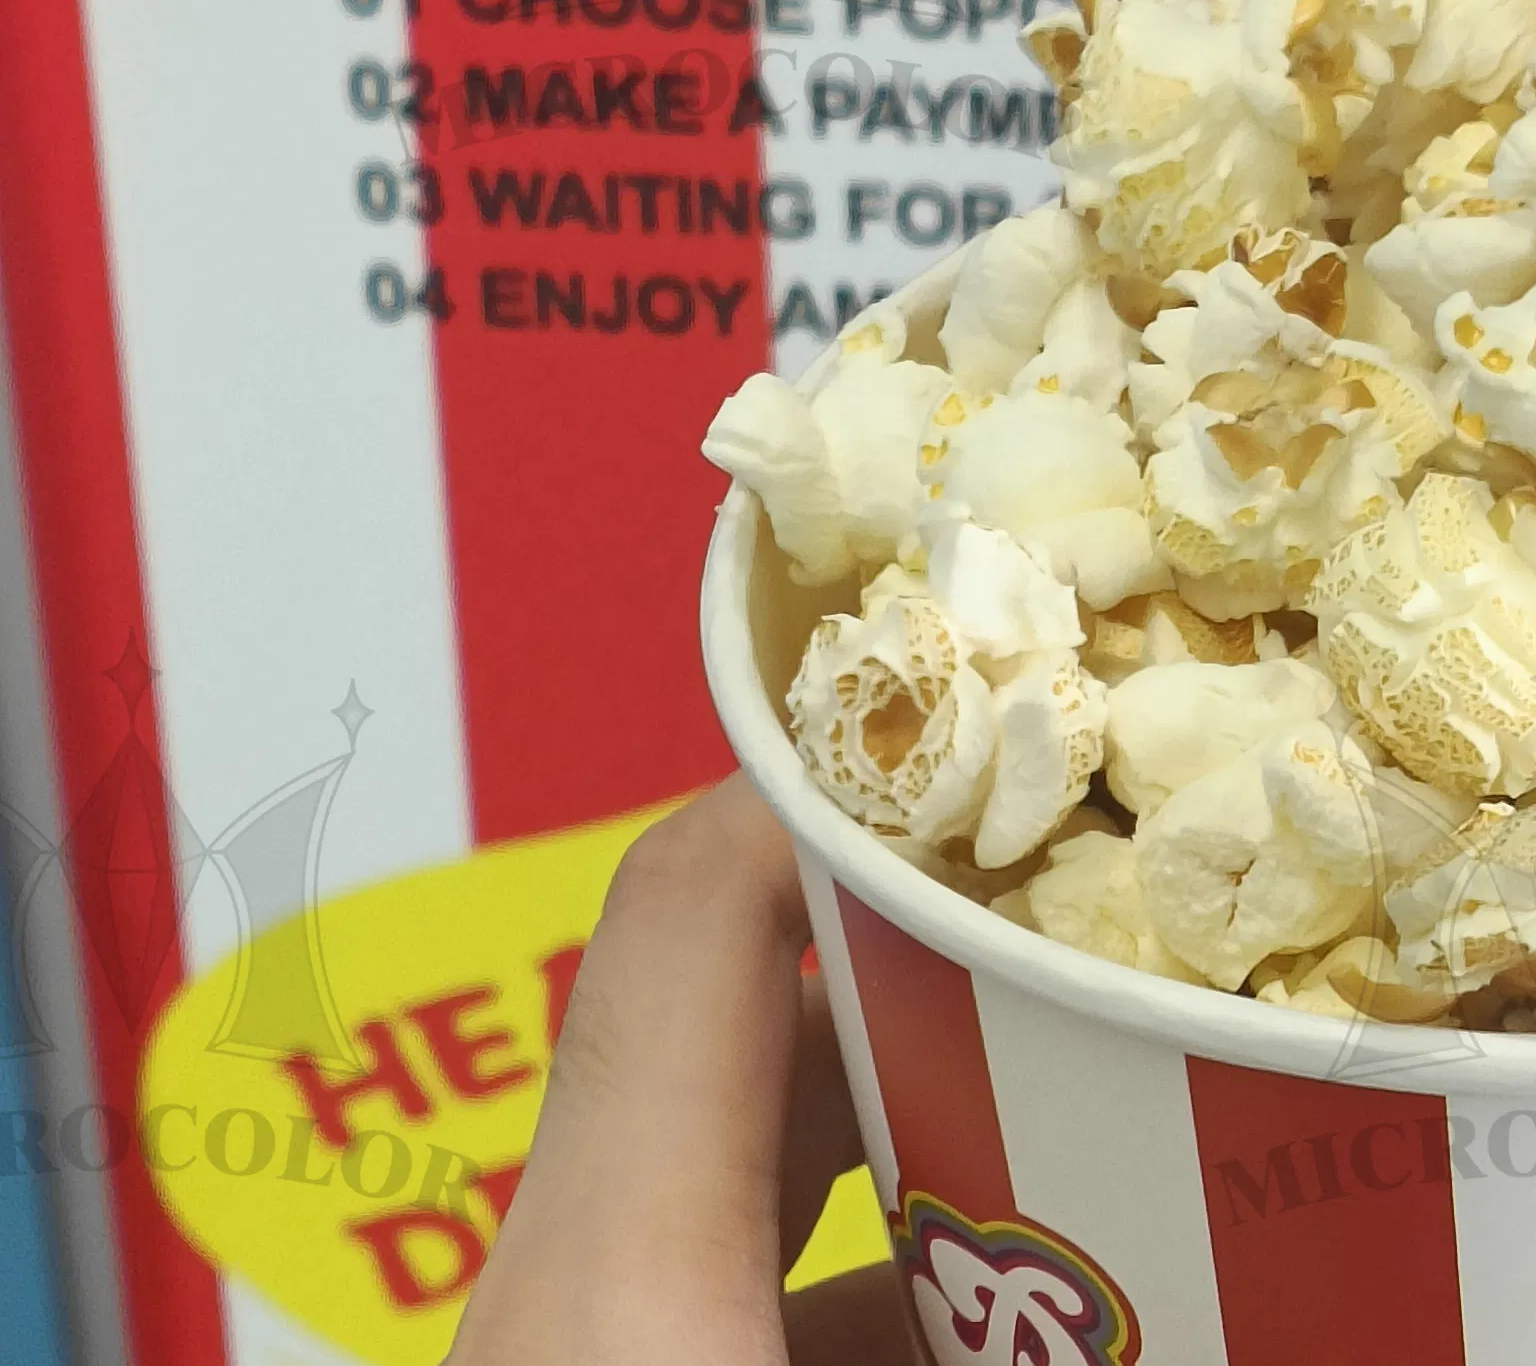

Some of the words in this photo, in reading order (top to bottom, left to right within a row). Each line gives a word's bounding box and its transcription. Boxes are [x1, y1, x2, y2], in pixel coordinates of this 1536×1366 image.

[348, 59, 438, 125] 02
[462, 66, 706, 133] MAKE
[727, 75, 786, 137] A
[356, 161, 444, 227] 03
[468, 166, 820, 240] WAITING
[845, 179, 1012, 247] FOR
[364, 261, 454, 325] 04
[480, 267, 751, 337] ENJOY
